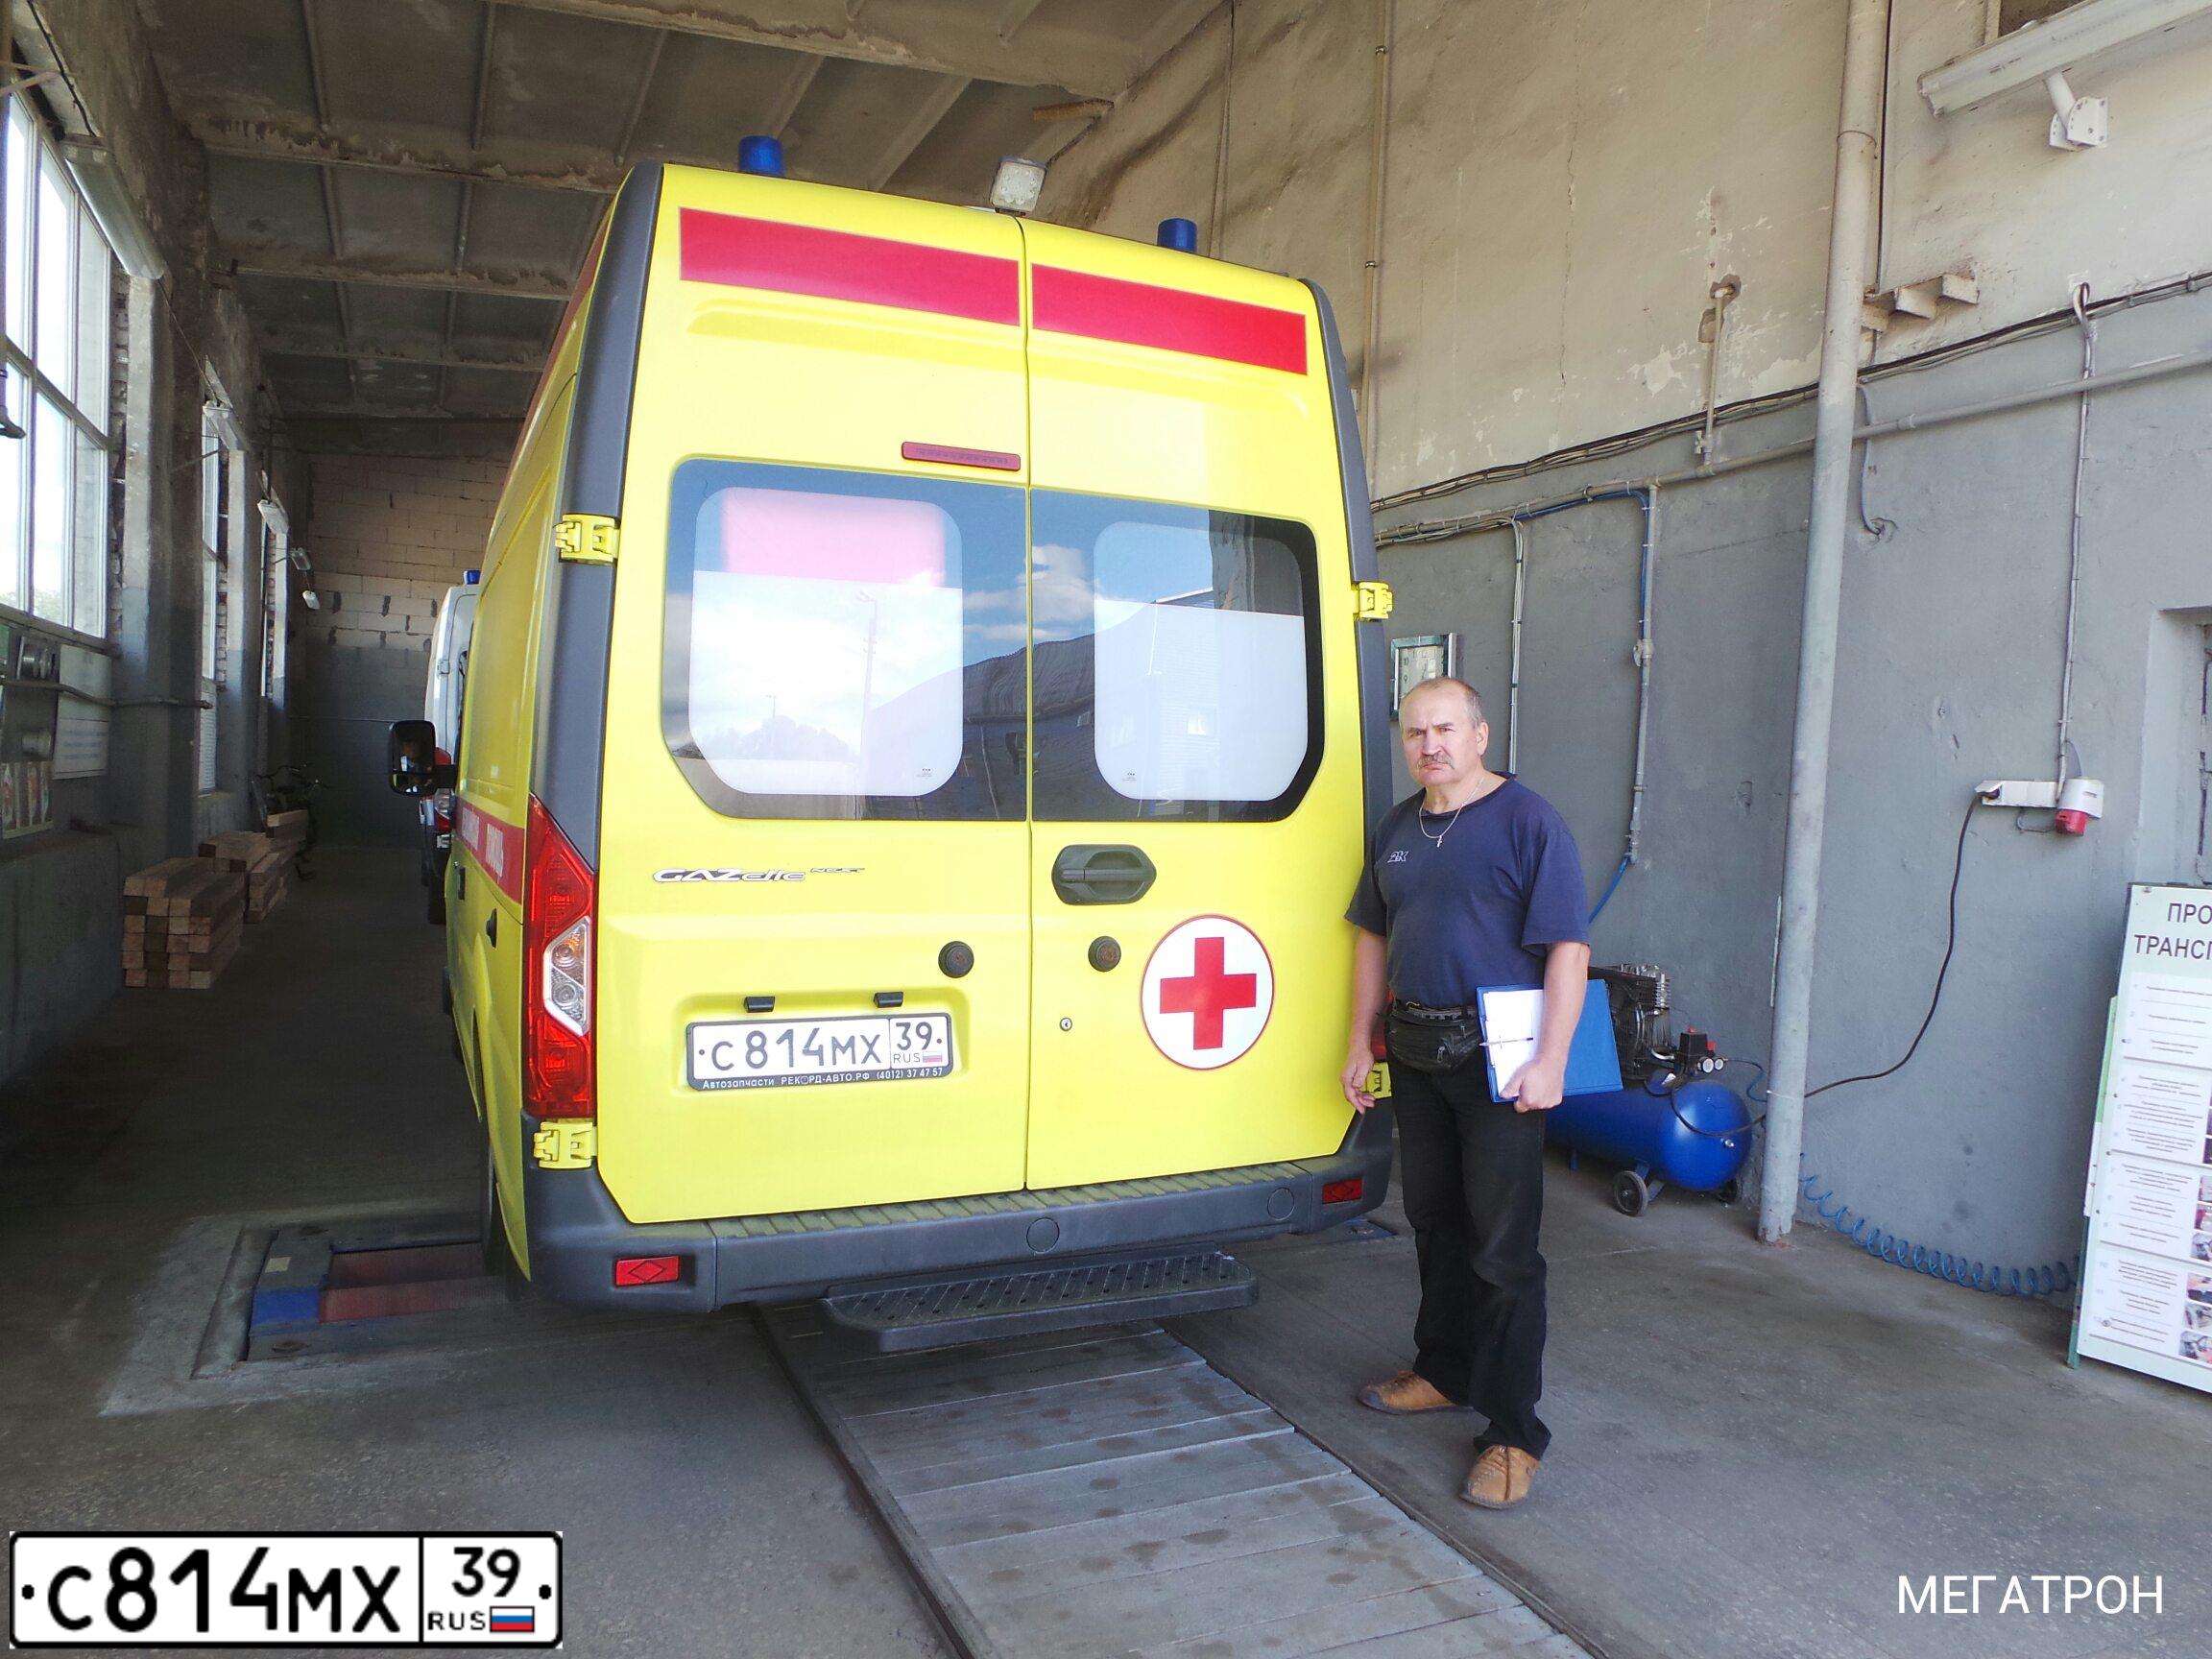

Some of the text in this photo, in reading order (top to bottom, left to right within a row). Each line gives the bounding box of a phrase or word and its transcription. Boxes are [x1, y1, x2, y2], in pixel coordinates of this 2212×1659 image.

[2167, 902, 2212, 925] ПРО
[895, 1022, 933, 1051] 39
[893, 1052, 921, 1064] RUS
[702, 1077, 775, 1090] Автозапчасти
[877, 1069, 903, 1080] (4012)
